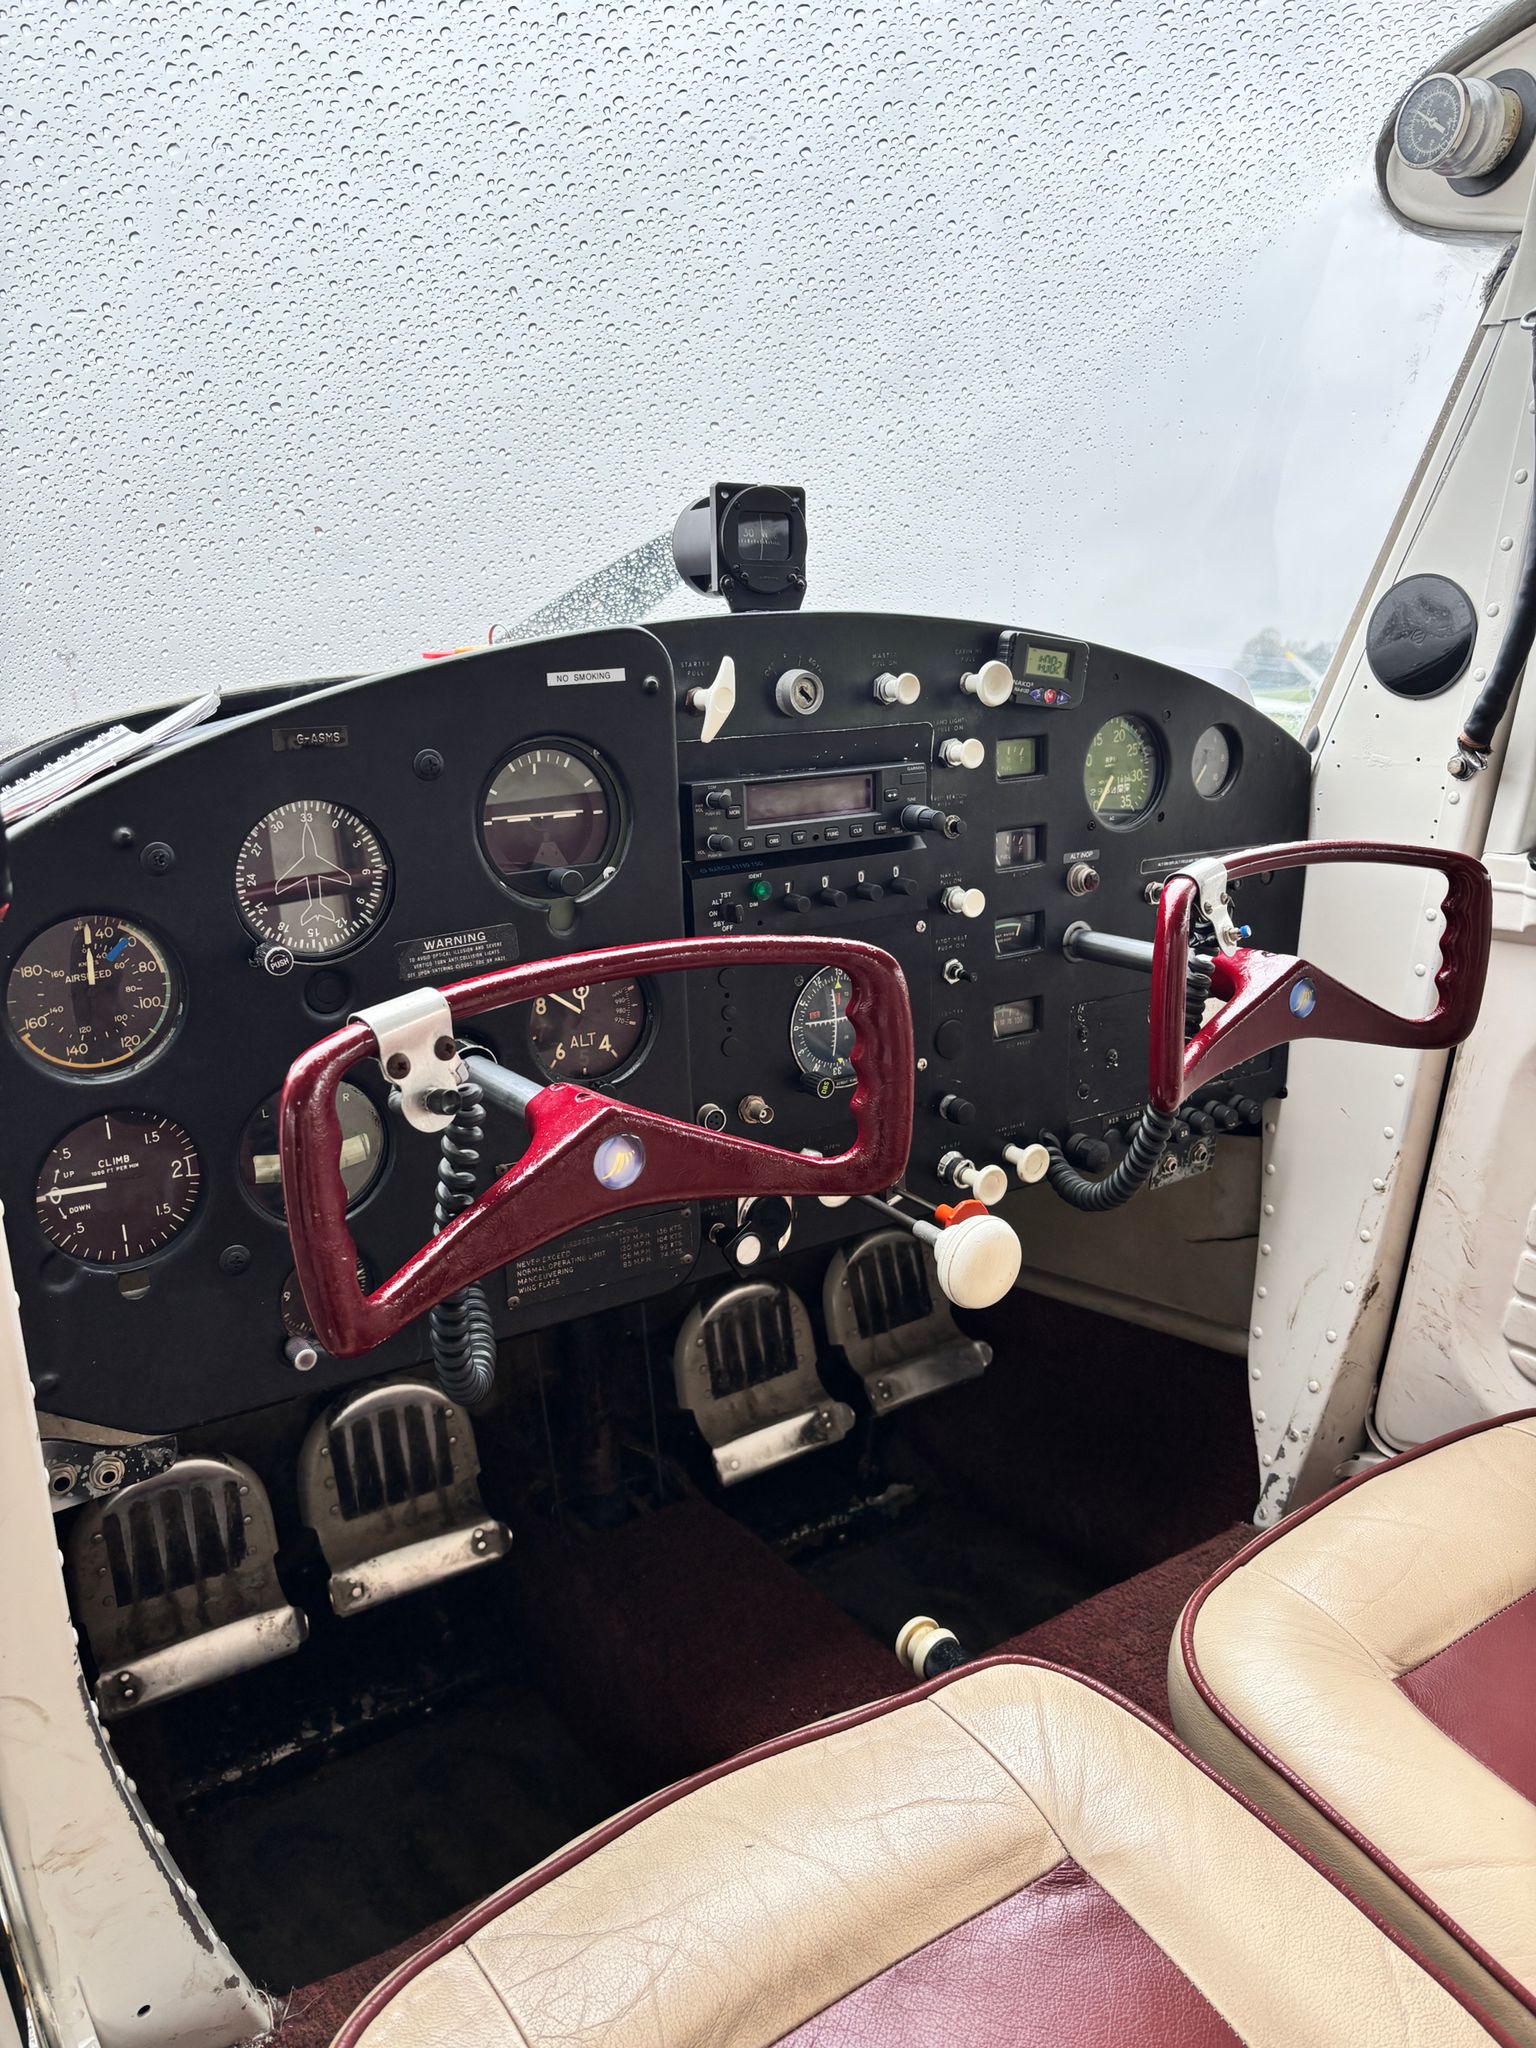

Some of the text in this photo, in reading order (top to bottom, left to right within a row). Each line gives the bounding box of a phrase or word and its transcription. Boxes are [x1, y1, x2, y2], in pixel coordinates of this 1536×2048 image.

[556, 671, 611, 684] NO SMOKING
[1113, 729, 1126, 743] 20
[1127, 743, 1139, 757] 25
[1131, 769, 1143, 782] 30
[1120, 795, 1132, 808] 35
[300, 813, 314, 823] 33
[331, 820, 340, 829] 0
[270, 820, 284, 834] 30
[251, 842, 263, 858] 27
[352, 839, 362, 849] 3
[361, 868, 371, 876] 6
[247, 873, 257, 887] 24
[785, 866, 900, 894] 7 0 0 0
[356, 897, 366, 905] 9
[711, 898, 723, 906] ALT
[254, 901, 269, 915] 21
[708, 910, 718, 918] ON
[277, 921, 290, 934] 18
[335, 917, 348, 929] 12
[713, 920, 725, 928] SBY
[721, 924, 734, 932] OFF
[95, 926, 114, 939] 40
[307, 928, 321, 938] 15
[423, 931, 486, 950] WARNING
[417, 954, 432, 962] AVOID
[453, 947, 474, 955] ILLUSION
[20, 964, 43, 978] 180
[114, 962, 125, 970] 60
[138, 961, 157, 972] 80
[270, 958, 290, 971] PUSH
[413, 961, 433, 970] VERTIGO
[50, 970, 65, 978] 160
[65, 970, 112, 984] AIRSEED
[813, 976, 823, 987] 12
[125, 985, 136, 993] 80
[139, 996, 161, 1009] 100
[535, 997, 547, 1016] 8
[50, 1006, 64, 1014] 140
[24, 1016, 48, 1030] 160
[114, 1014, 128, 1022] 100
[79, 1026, 92, 1034] 120
[120, 1035, 141, 1048] 120
[570, 1032, 597, 1049] ALT
[598, 1034, 612, 1052] 4
[66, 1043, 89, 1057] 140
[555, 1042, 566, 1060] 6
[813, 1063, 821, 1072] N
[833, 1066, 842, 1076] 33
[821, 1081, 830, 1095] OBS
[342, 1093, 350, 1102] R
[261, 1109, 270, 1118] L
[144, 1131, 160, 1144] 1.5
[59, 1148, 72, 1161] .5
[97, 1154, 130, 1168] CLIMB
[63, 1171, 75, 1179] UP
[91, 1169, 105, 1177] 1000
[171, 1160, 183, 1178] 2
[69, 1203, 92, 1214] DOWN
[156, 1203, 172, 1216] 1.5
[73, 1222, 85, 1236] .5
[542, 1250, 571, 1263] EXCEED
[669, 1224, 682, 1232] KTS
[516, 1266, 546, 1278] NORMAL
[548, 1255, 587, 1270] OPERATING
[669, 1232, 683, 1240] KTS
[518, 1284, 537, 1294] WING
[538, 1278, 561, 1289] FLAPS
[671, 1248, 684, 1256] KTS
[283, 1291, 291, 1302] 9
